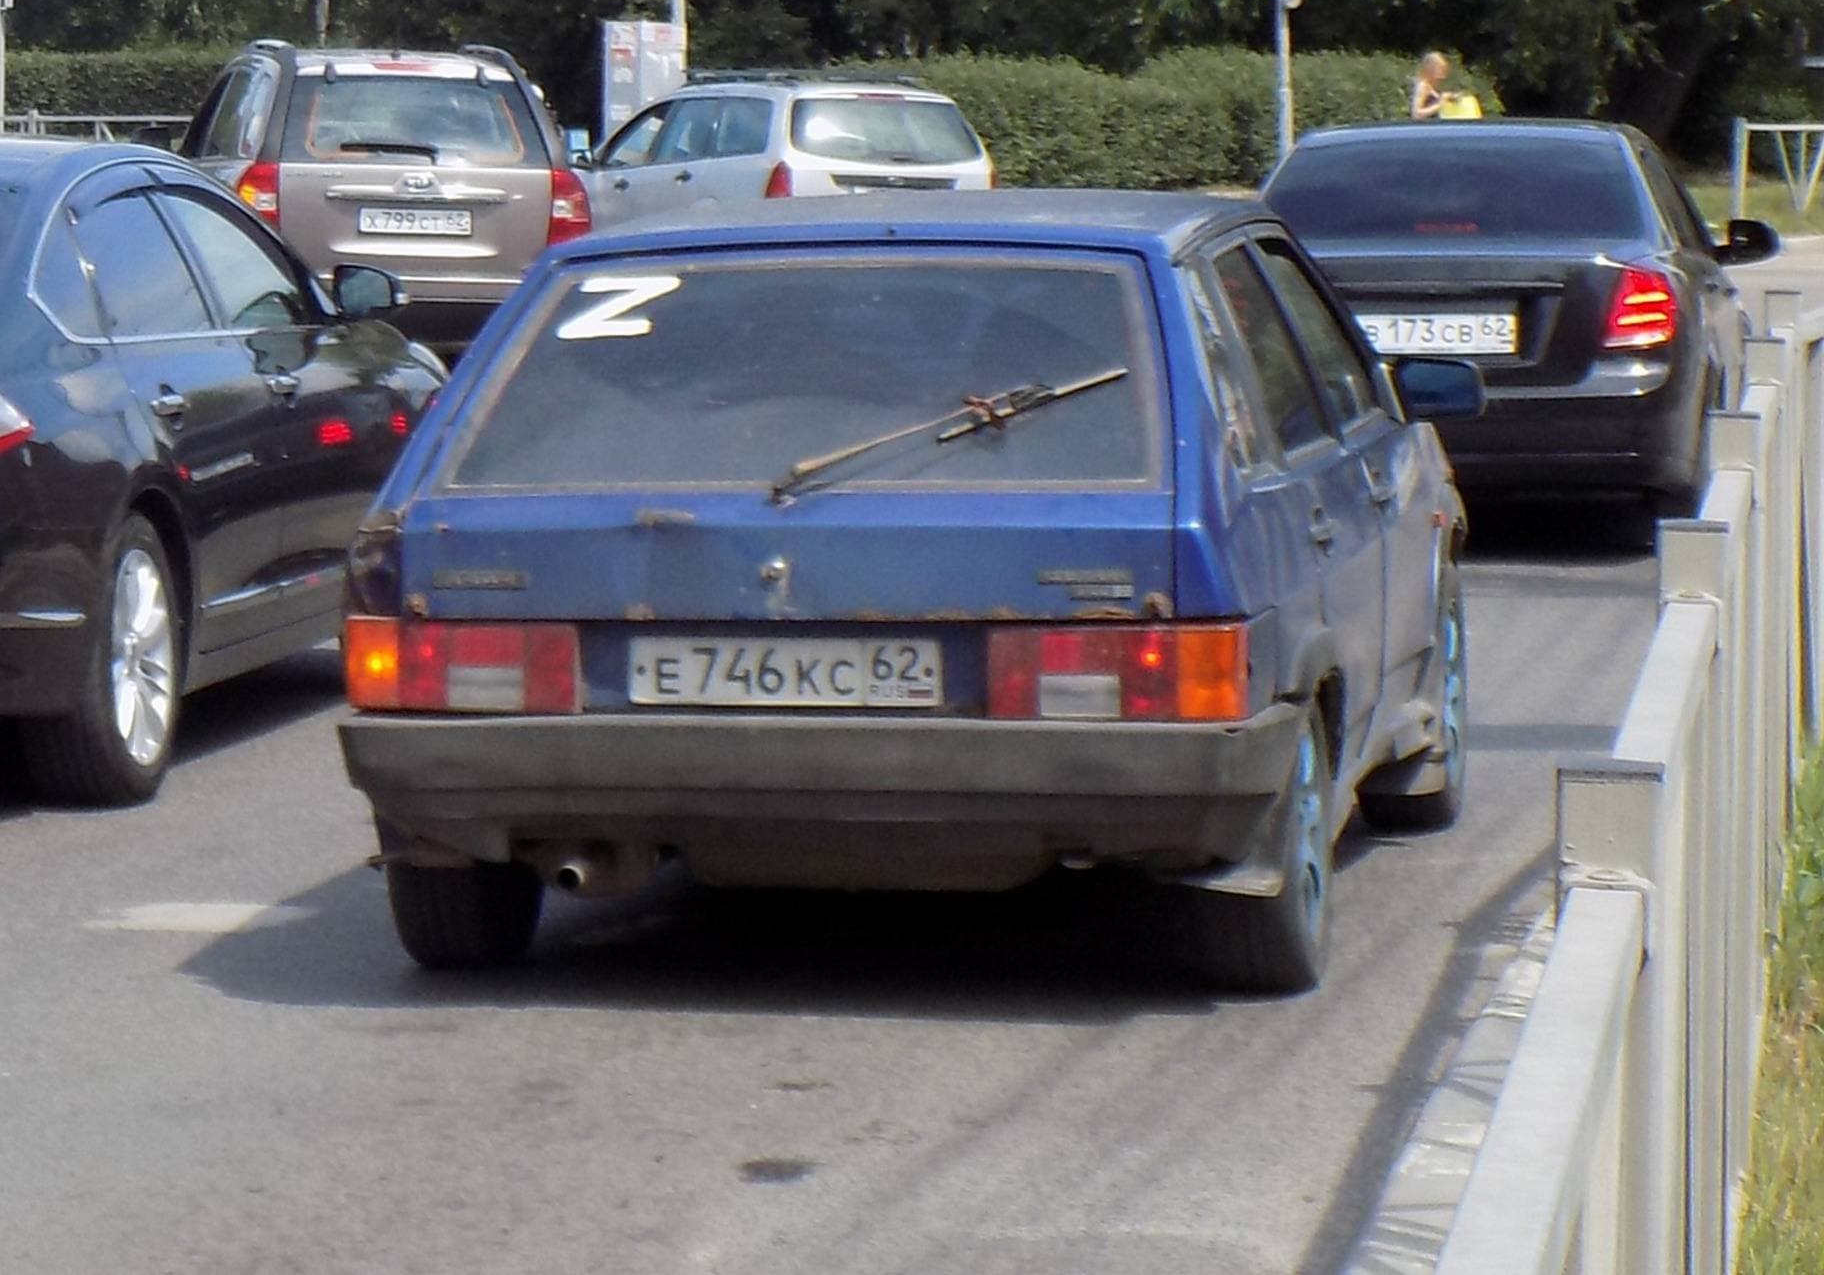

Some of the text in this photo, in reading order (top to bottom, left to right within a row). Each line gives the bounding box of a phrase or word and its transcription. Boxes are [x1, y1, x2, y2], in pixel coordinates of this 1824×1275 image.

[556, 275, 682, 340] Z
[655, 645, 921, 696] Е746КС 62
